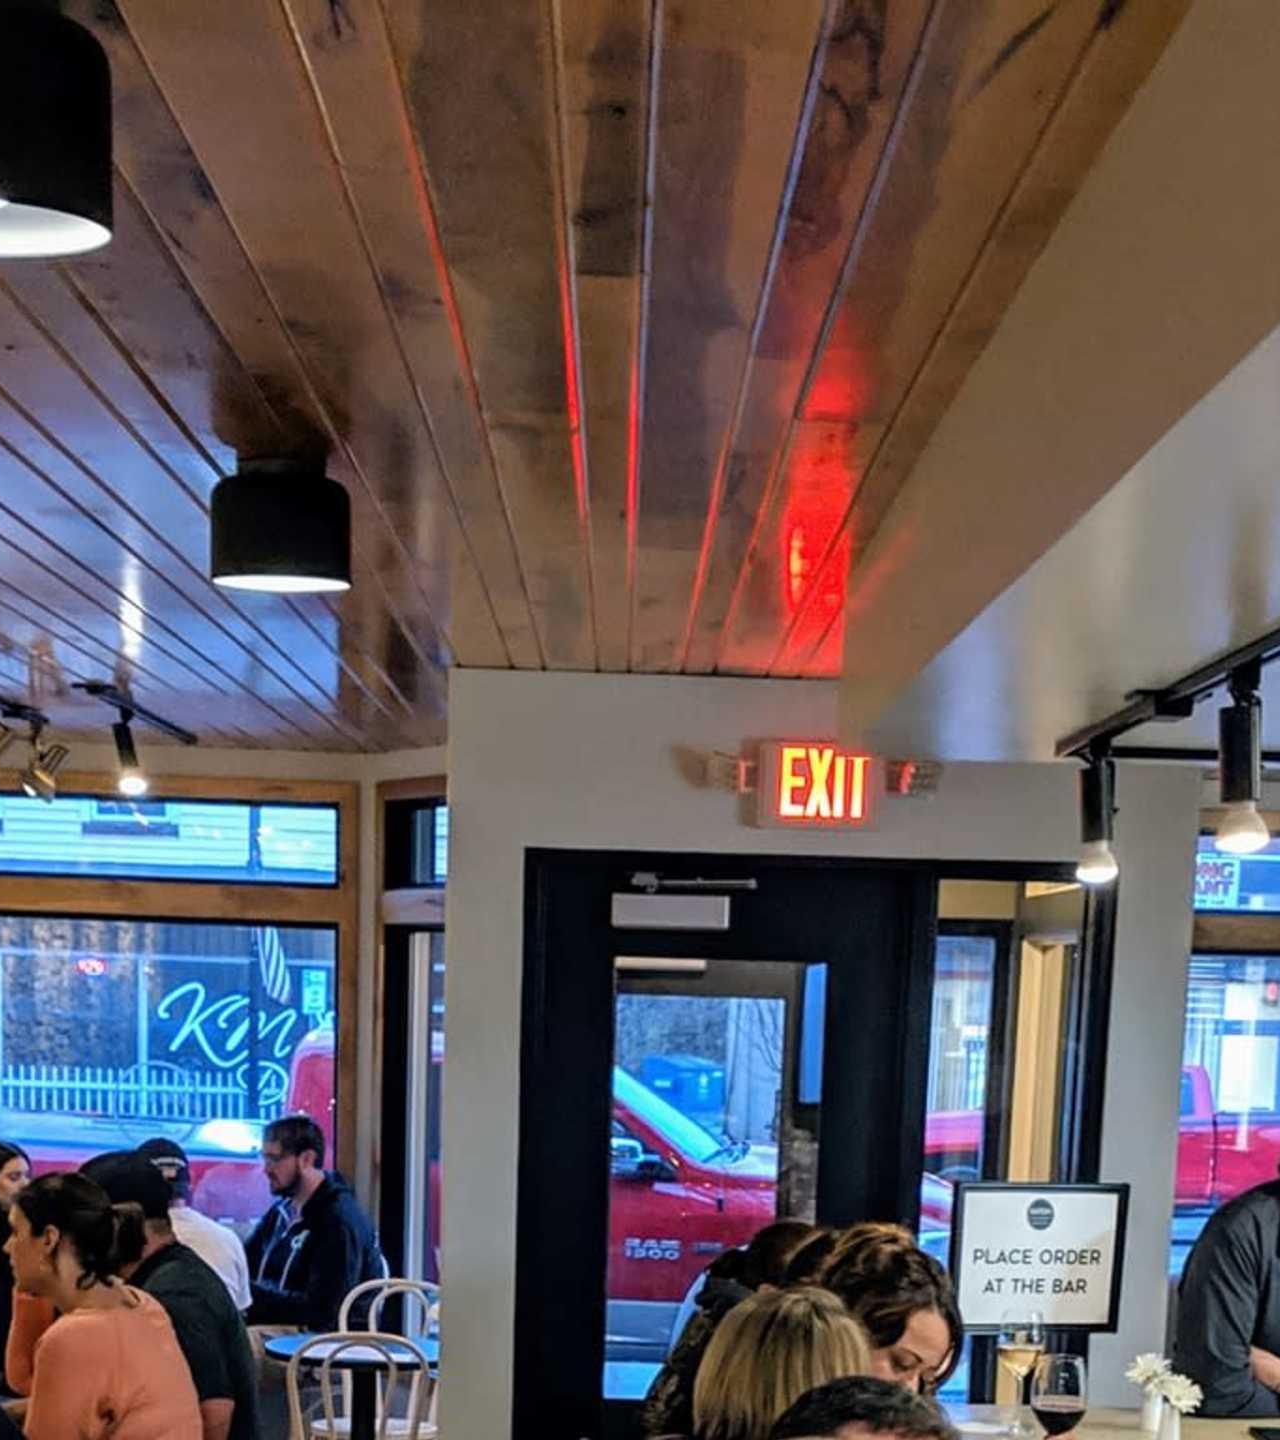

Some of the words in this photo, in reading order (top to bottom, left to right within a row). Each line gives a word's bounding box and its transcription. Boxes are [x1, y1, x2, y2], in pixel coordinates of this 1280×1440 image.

[780, 747, 872, 818] EXIT
[972, 1249, 1033, 1266] PLACE
[1039, 1249, 1102, 1266] ORDER
[982, 1278, 1005, 1294] AT
[1011, 1278, 1046, 1294] THE
[1051, 1278, 1088, 1294] BAR
